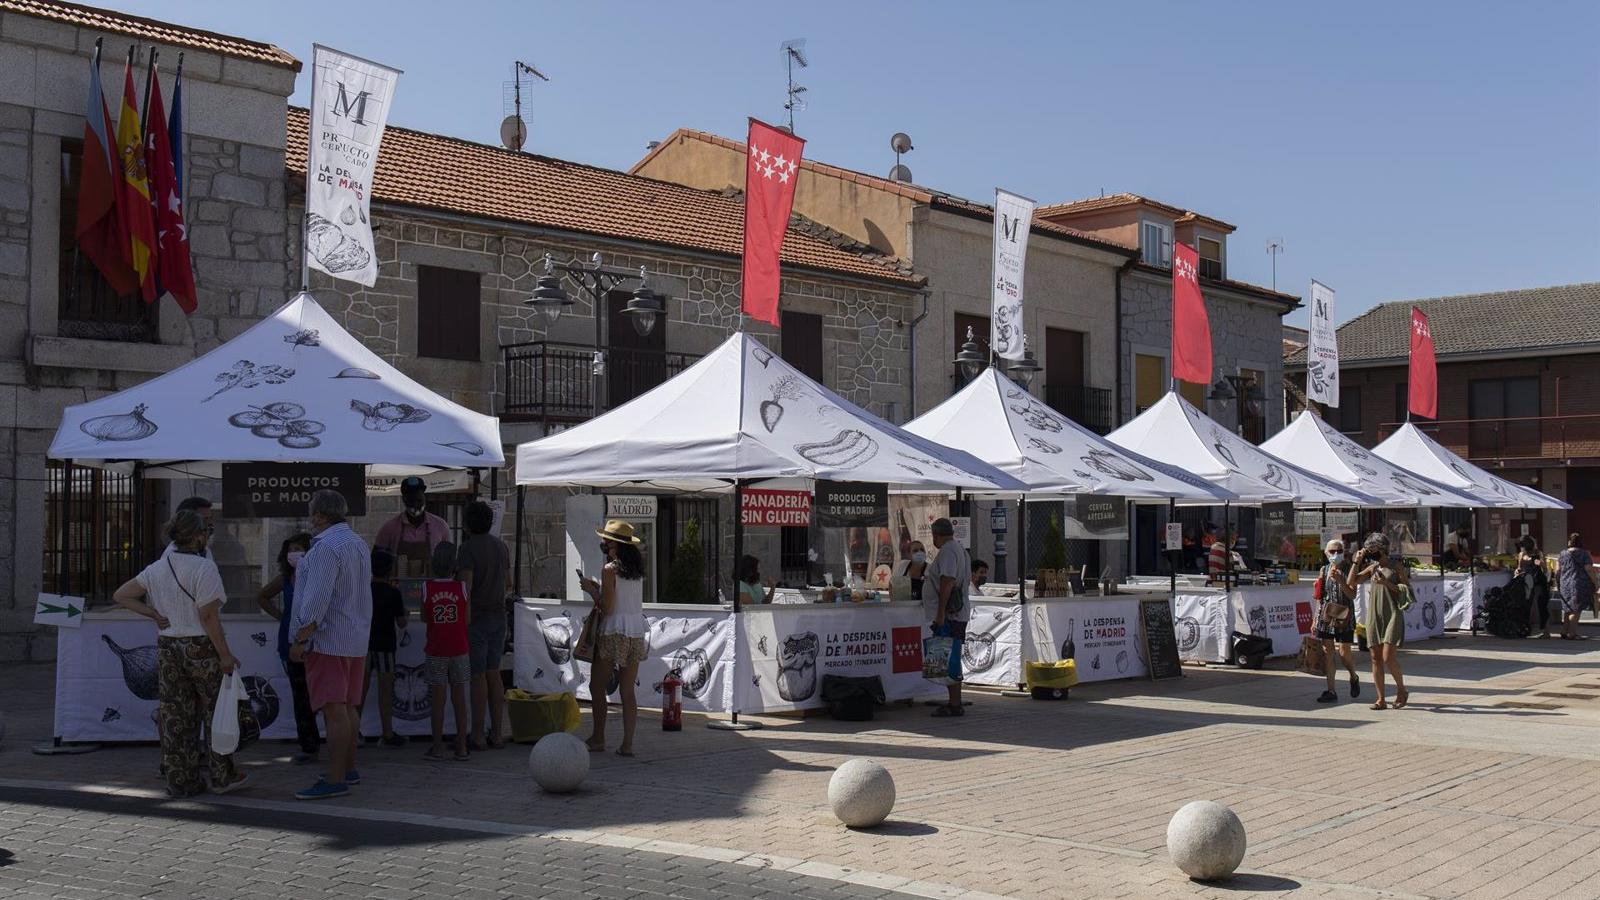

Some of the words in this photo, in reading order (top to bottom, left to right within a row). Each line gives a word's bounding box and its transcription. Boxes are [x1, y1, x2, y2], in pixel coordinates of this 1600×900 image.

[329, 80, 373, 126] M
[322, 131, 370, 160] PRUCTO
[319, 163, 331, 174] LA
[317, 173, 333, 185] DE
[1001, 213, 1021, 244] M
[1314, 297, 1329, 321] M
[247, 477, 341, 488] PRODUCTOS
[252, 492, 271, 503] DE
[279, 492, 312, 503] MAD
[741, 491, 810, 508] PANADERÍA
[828, 493, 876, 503] PRODUCTOS
[612, 505, 653, 514] MADRID
[830, 506, 842, 515] DE
[844, 506, 874, 515] MADRID
[1088, 503, 1113, 511] CERVEZA
[740, 510, 763, 523] SIN
[765, 510, 810, 524] GLUTEN
[432, 604, 459, 624] 23
[1083, 618, 1091, 627] LA
[1093, 617, 1125, 627] DESPENSA
[826, 633, 839, 643] LA
[843, 631, 887, 642] DESPENSA
[1084, 629, 1093, 639] DE
[1096, 627, 1126, 638] MADRID
[825, 646, 841, 657] DE
[846, 643, 886, 656] MADRID
[824, 660, 853, 668] MERCADO
[854, 658, 887, 666] ITINERANTE
